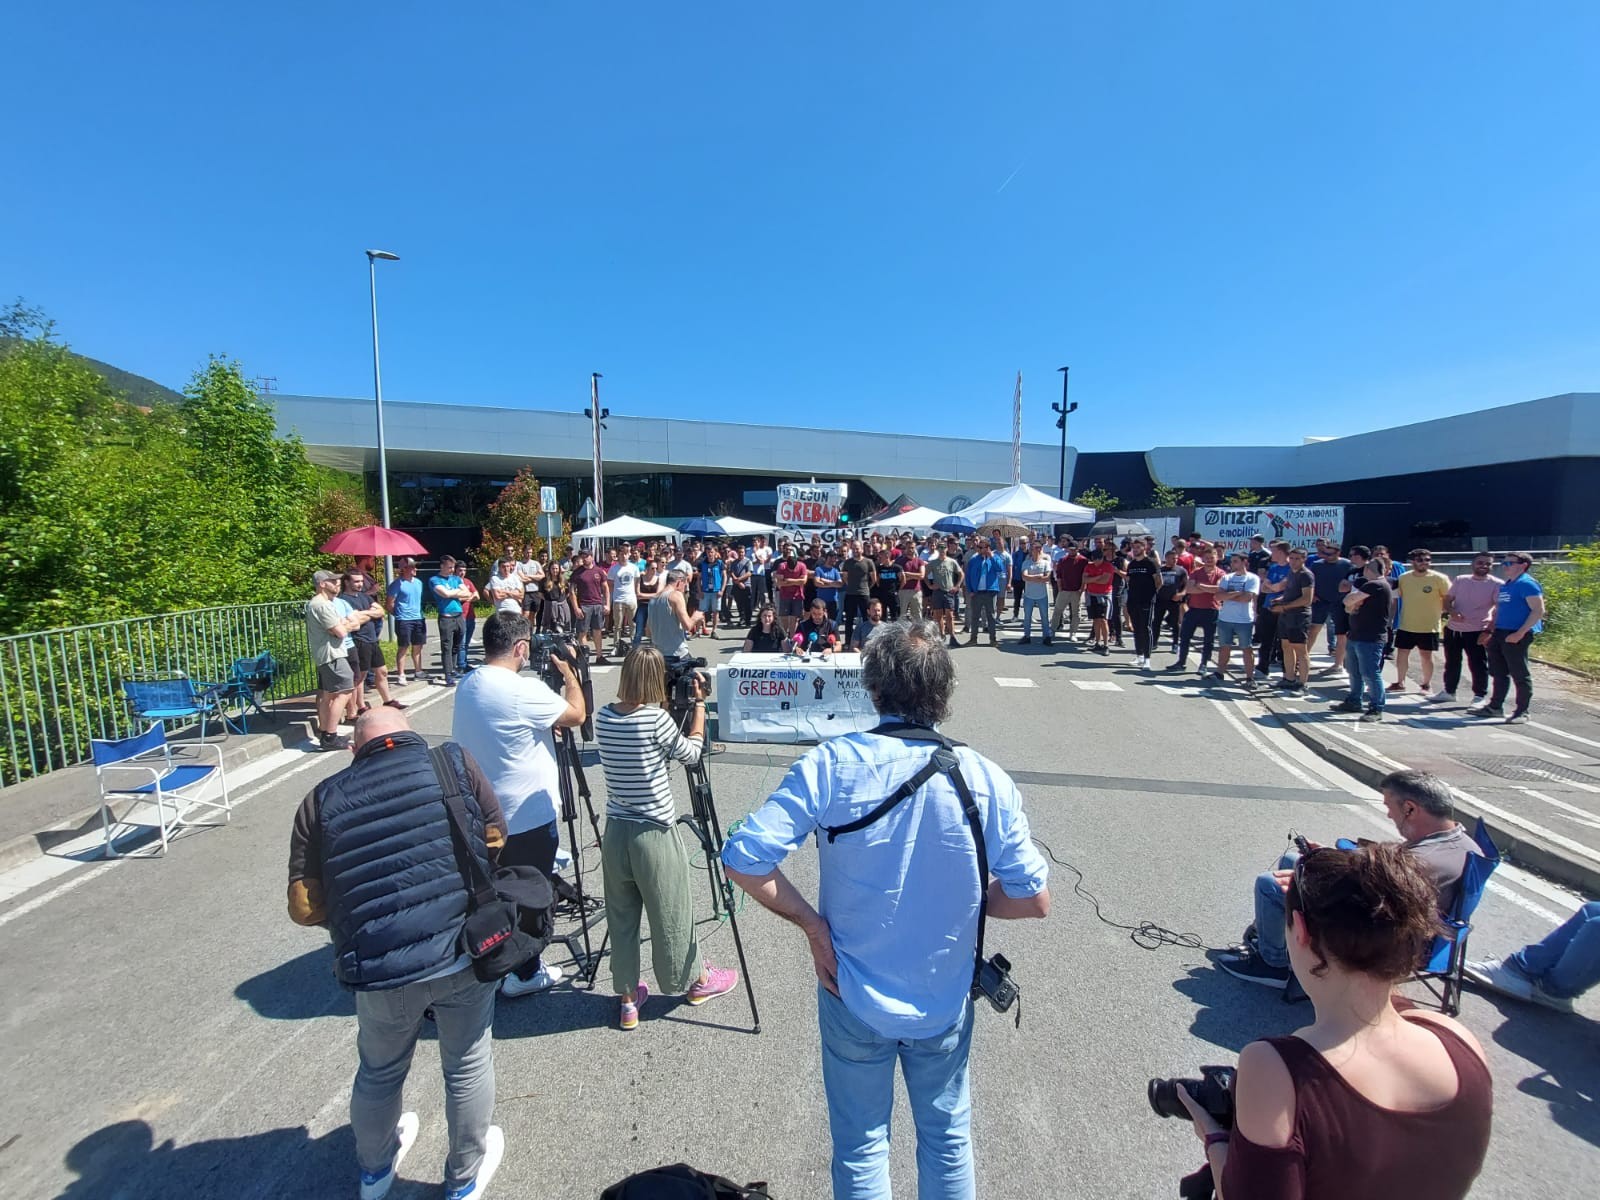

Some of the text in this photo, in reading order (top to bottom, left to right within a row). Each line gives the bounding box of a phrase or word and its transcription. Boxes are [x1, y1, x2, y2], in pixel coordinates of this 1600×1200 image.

[781, 501, 839, 523] GREBAN
[1220, 510, 1263, 525] Irizar
[1297, 521, 1335, 537] MANIFA
[740, 668, 770, 678] Irizar
[738, 680, 798, 697] GREBAN
